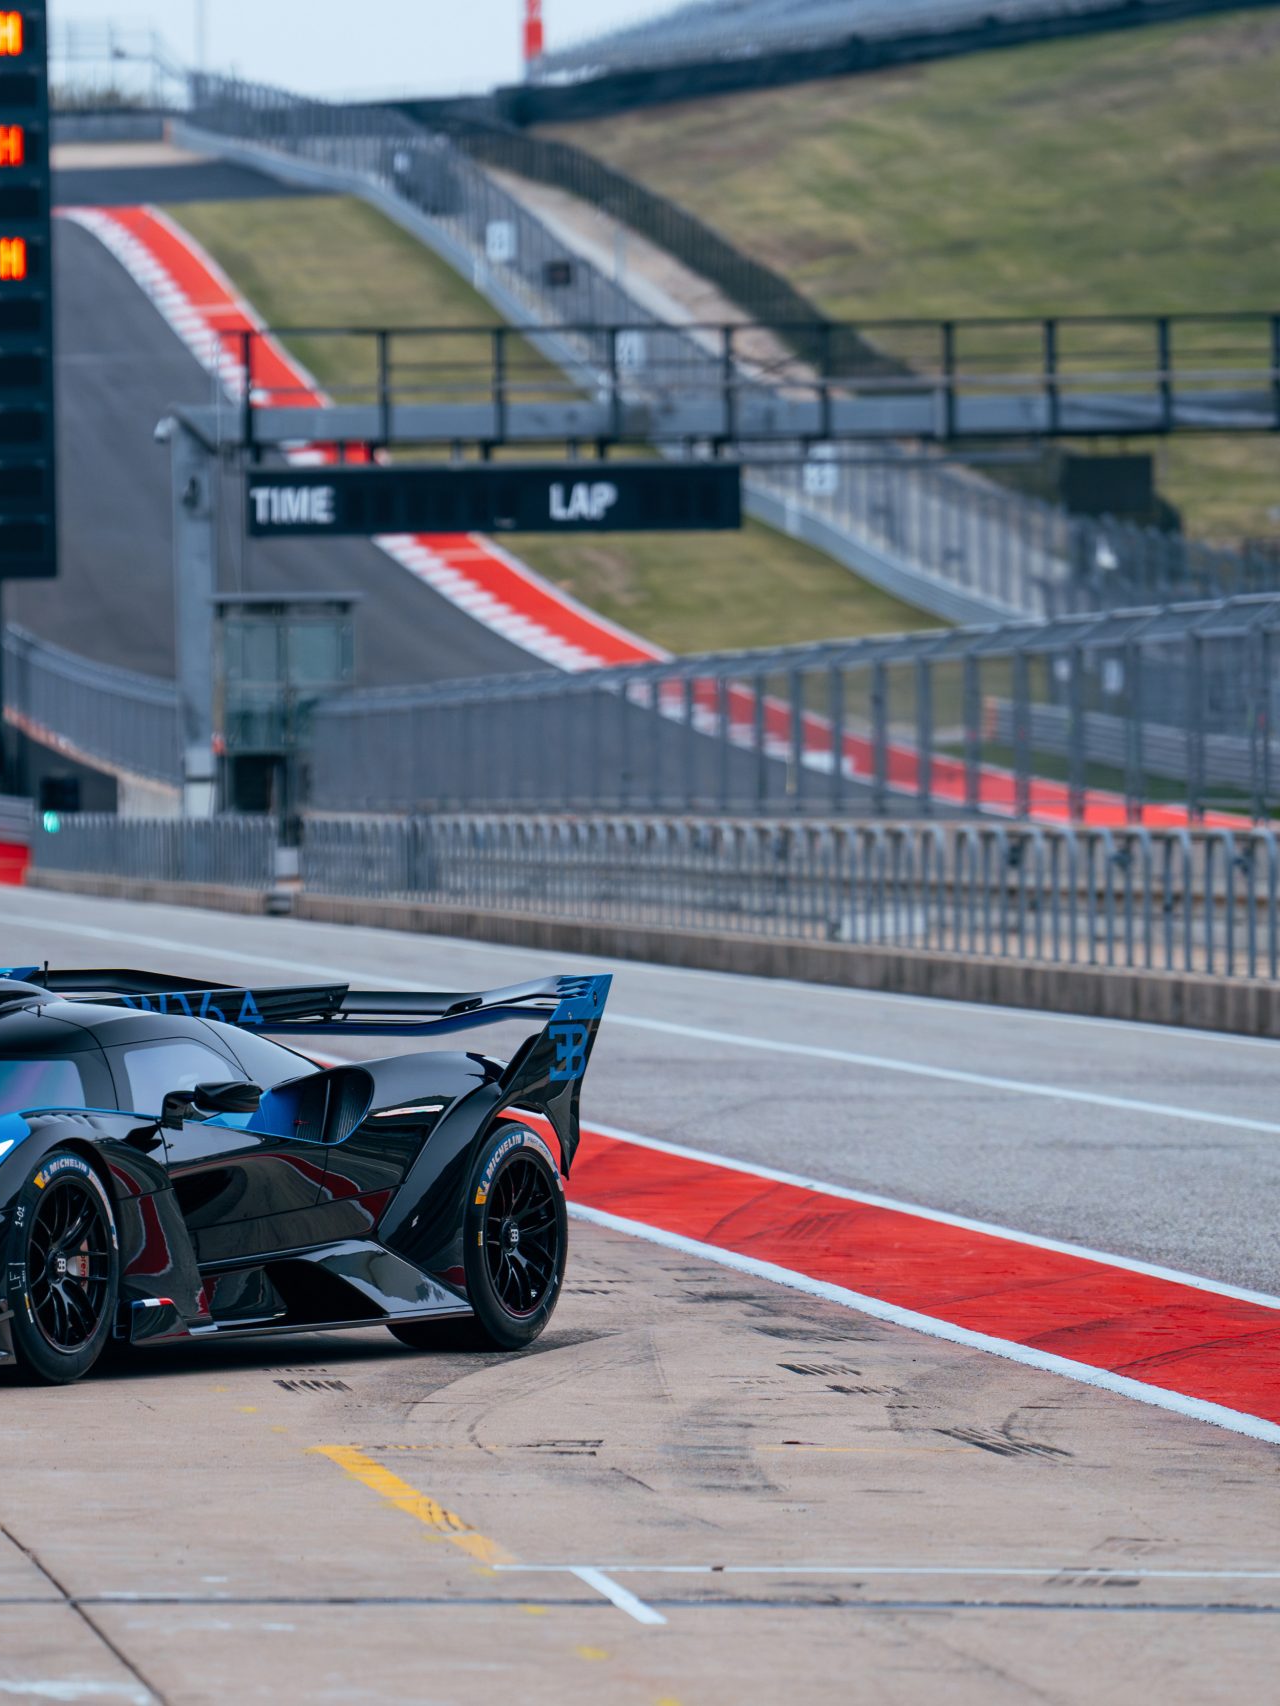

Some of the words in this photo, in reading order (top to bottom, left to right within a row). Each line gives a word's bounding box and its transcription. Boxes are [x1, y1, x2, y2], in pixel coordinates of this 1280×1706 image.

[251, 485, 335, 524] TIME
[548, 482, 617, 521] LAP
[49, 1158, 88, 1174] MICHELIN
[486, 1133, 522, 1179] MICHELIN
